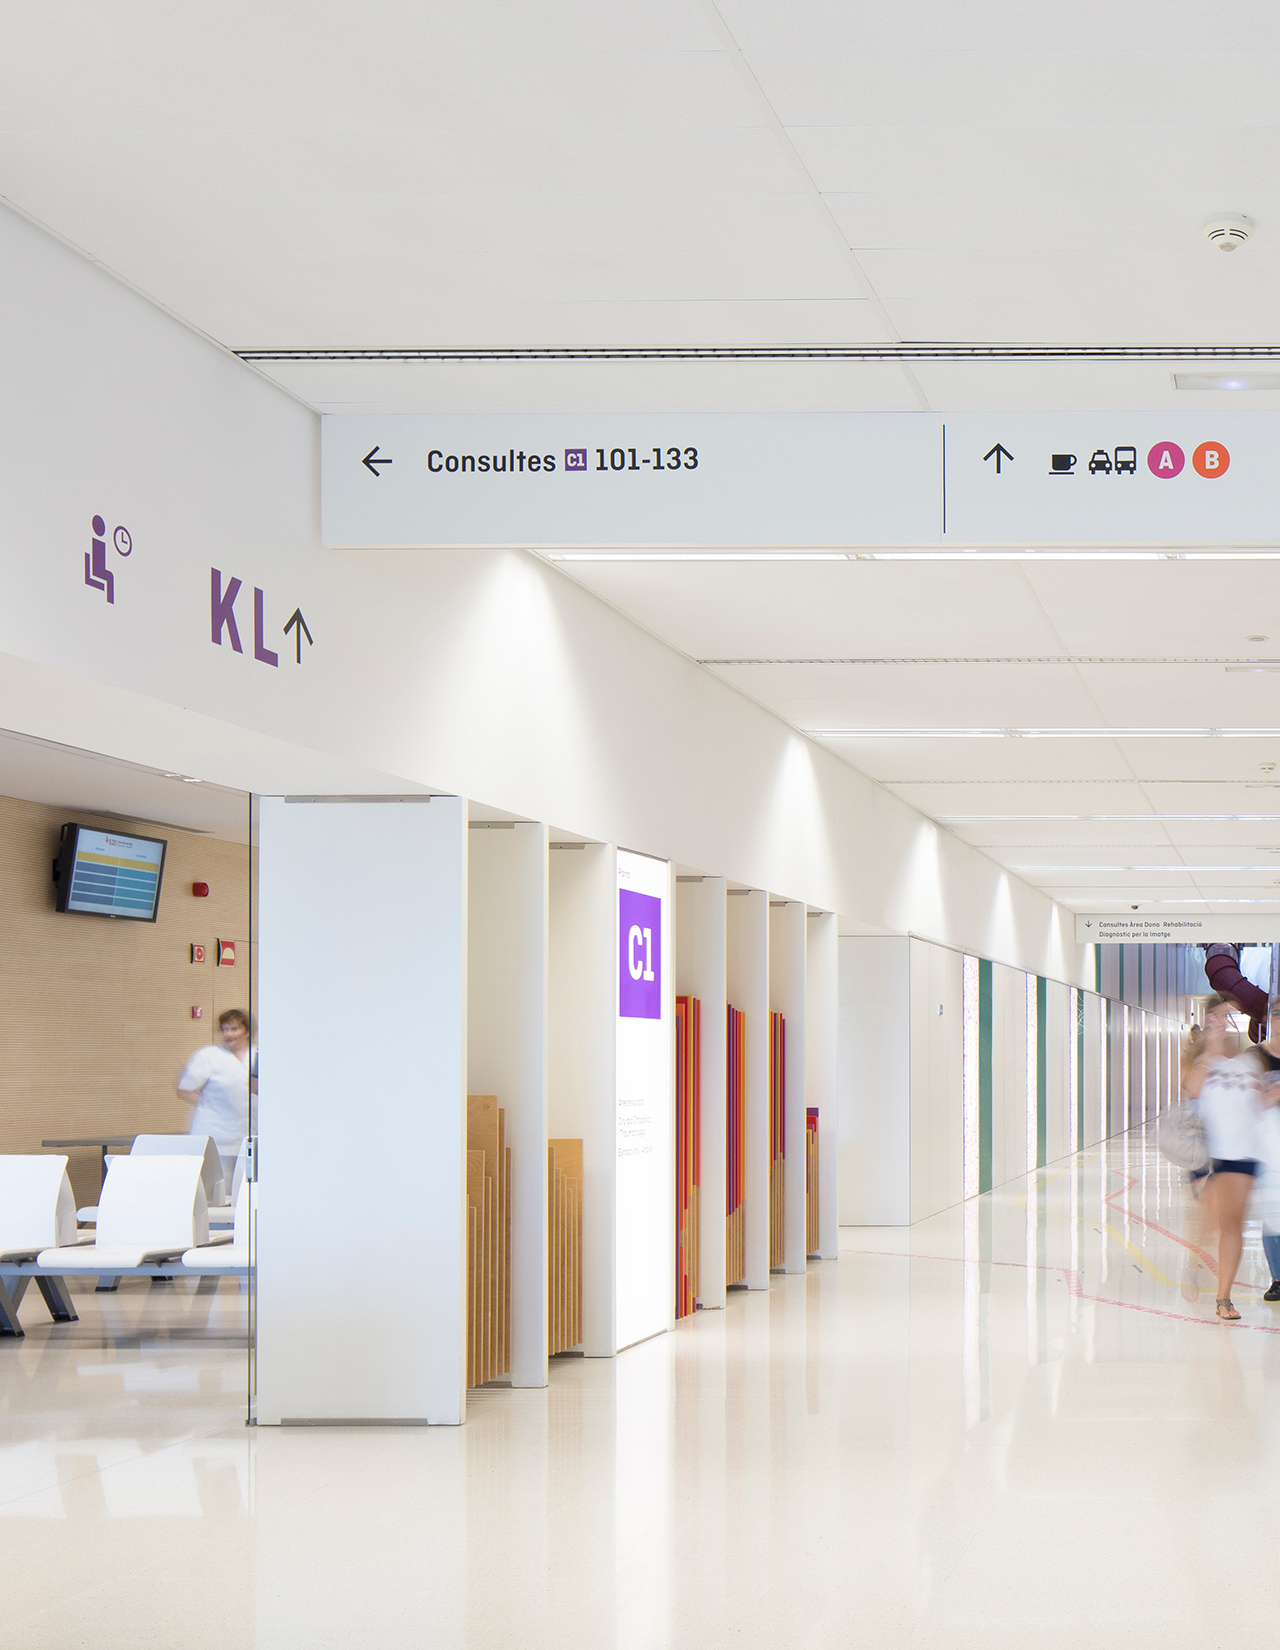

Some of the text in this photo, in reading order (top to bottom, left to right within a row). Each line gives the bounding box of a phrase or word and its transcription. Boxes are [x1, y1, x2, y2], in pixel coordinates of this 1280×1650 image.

[427, 447, 699, 473] Consultes C1 101-133
[1158, 450, 1220, 470] A B
[1098, 930, 1131, 938] Diagnòstic
[1162, 920, 1203, 928] Rehabilitació
[627, 923, 656, 982] C1
